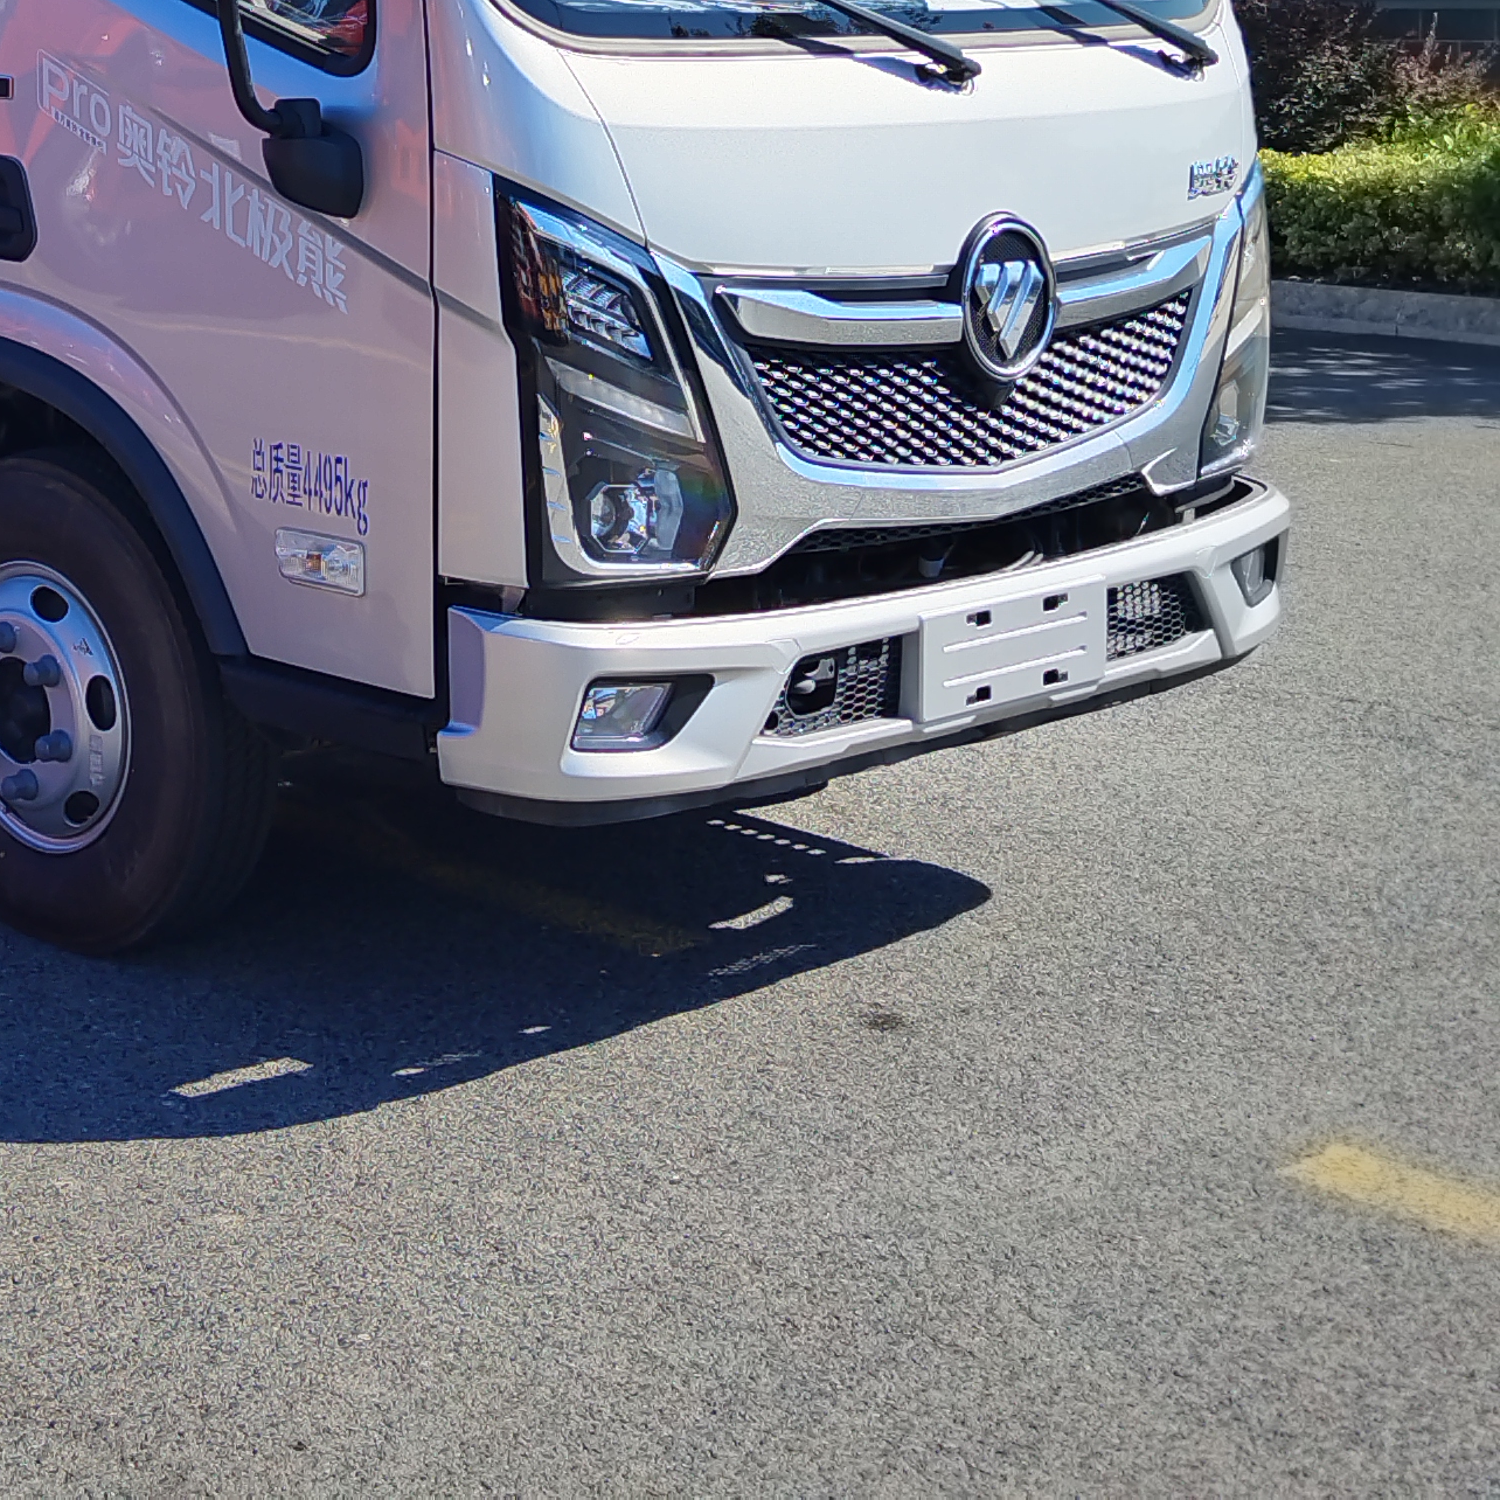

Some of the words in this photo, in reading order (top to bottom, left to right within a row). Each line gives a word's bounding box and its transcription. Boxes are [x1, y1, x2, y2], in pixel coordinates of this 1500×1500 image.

[41, 56, 112, 138] Pro
[250, 437, 369, 536] 总质量4495kg
